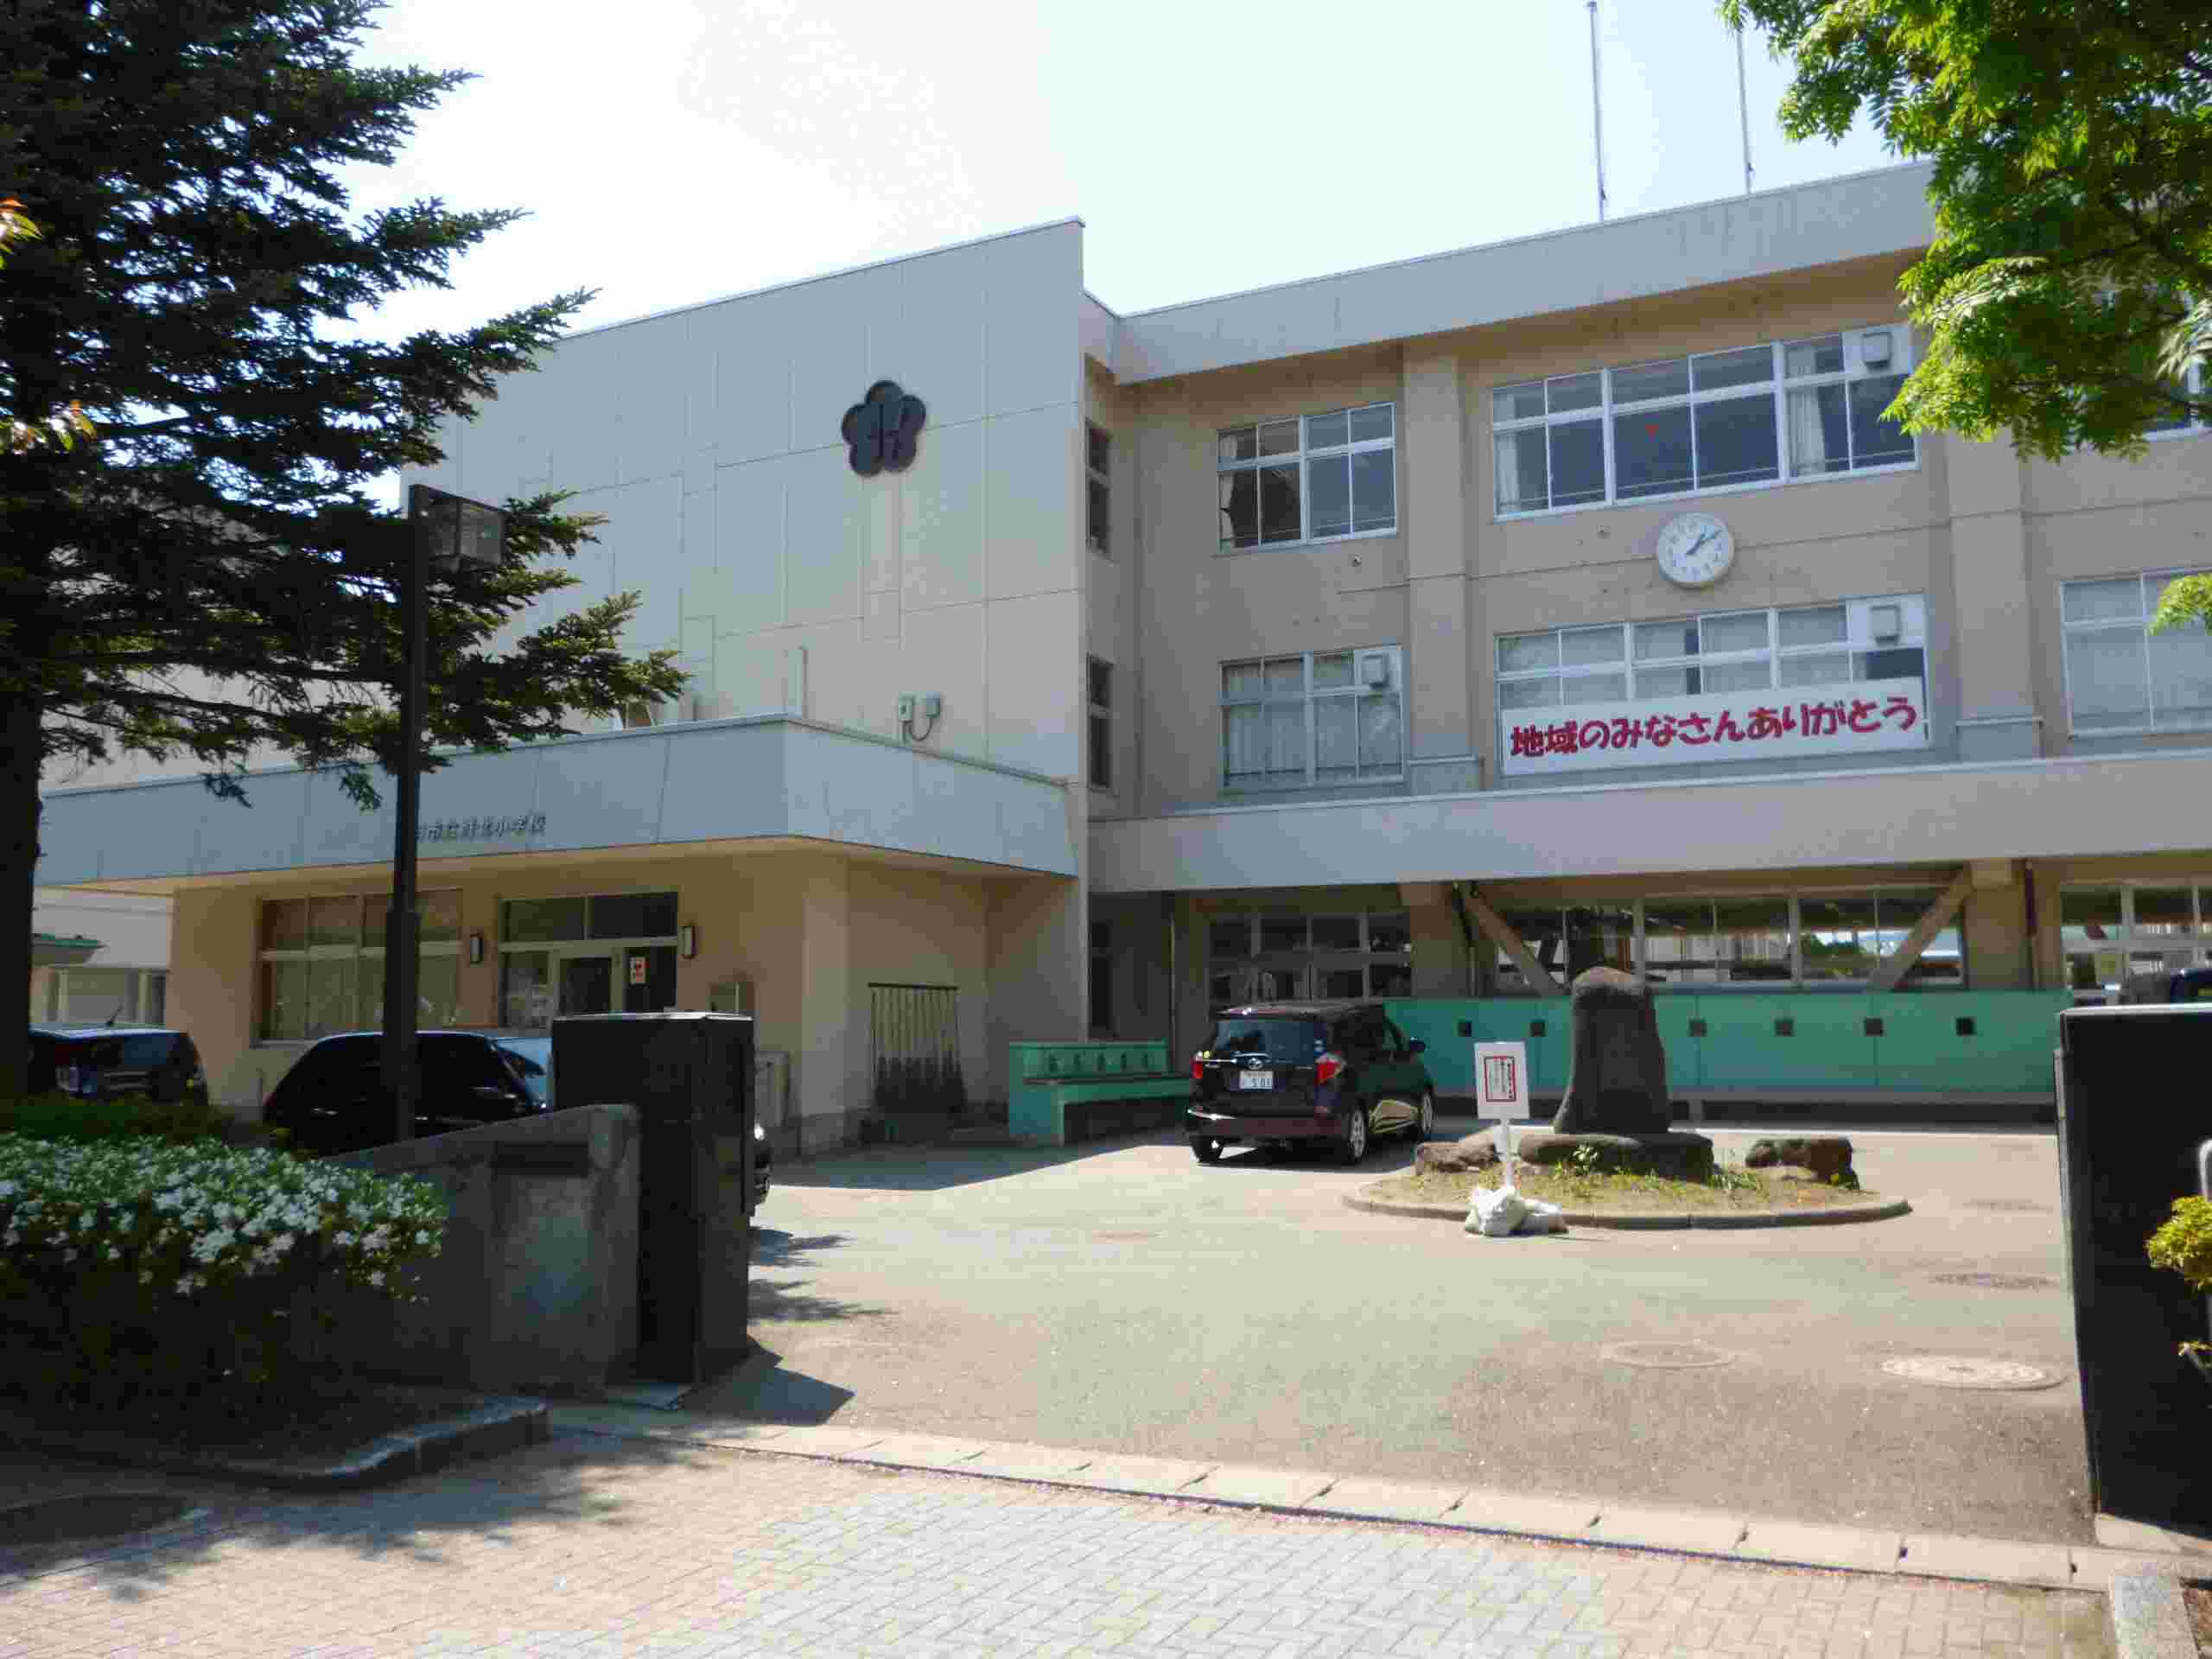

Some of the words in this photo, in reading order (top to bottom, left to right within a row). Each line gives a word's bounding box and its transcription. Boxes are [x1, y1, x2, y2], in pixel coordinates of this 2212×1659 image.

[1510, 696, 1917, 757] 地域のみなさんありがとう
